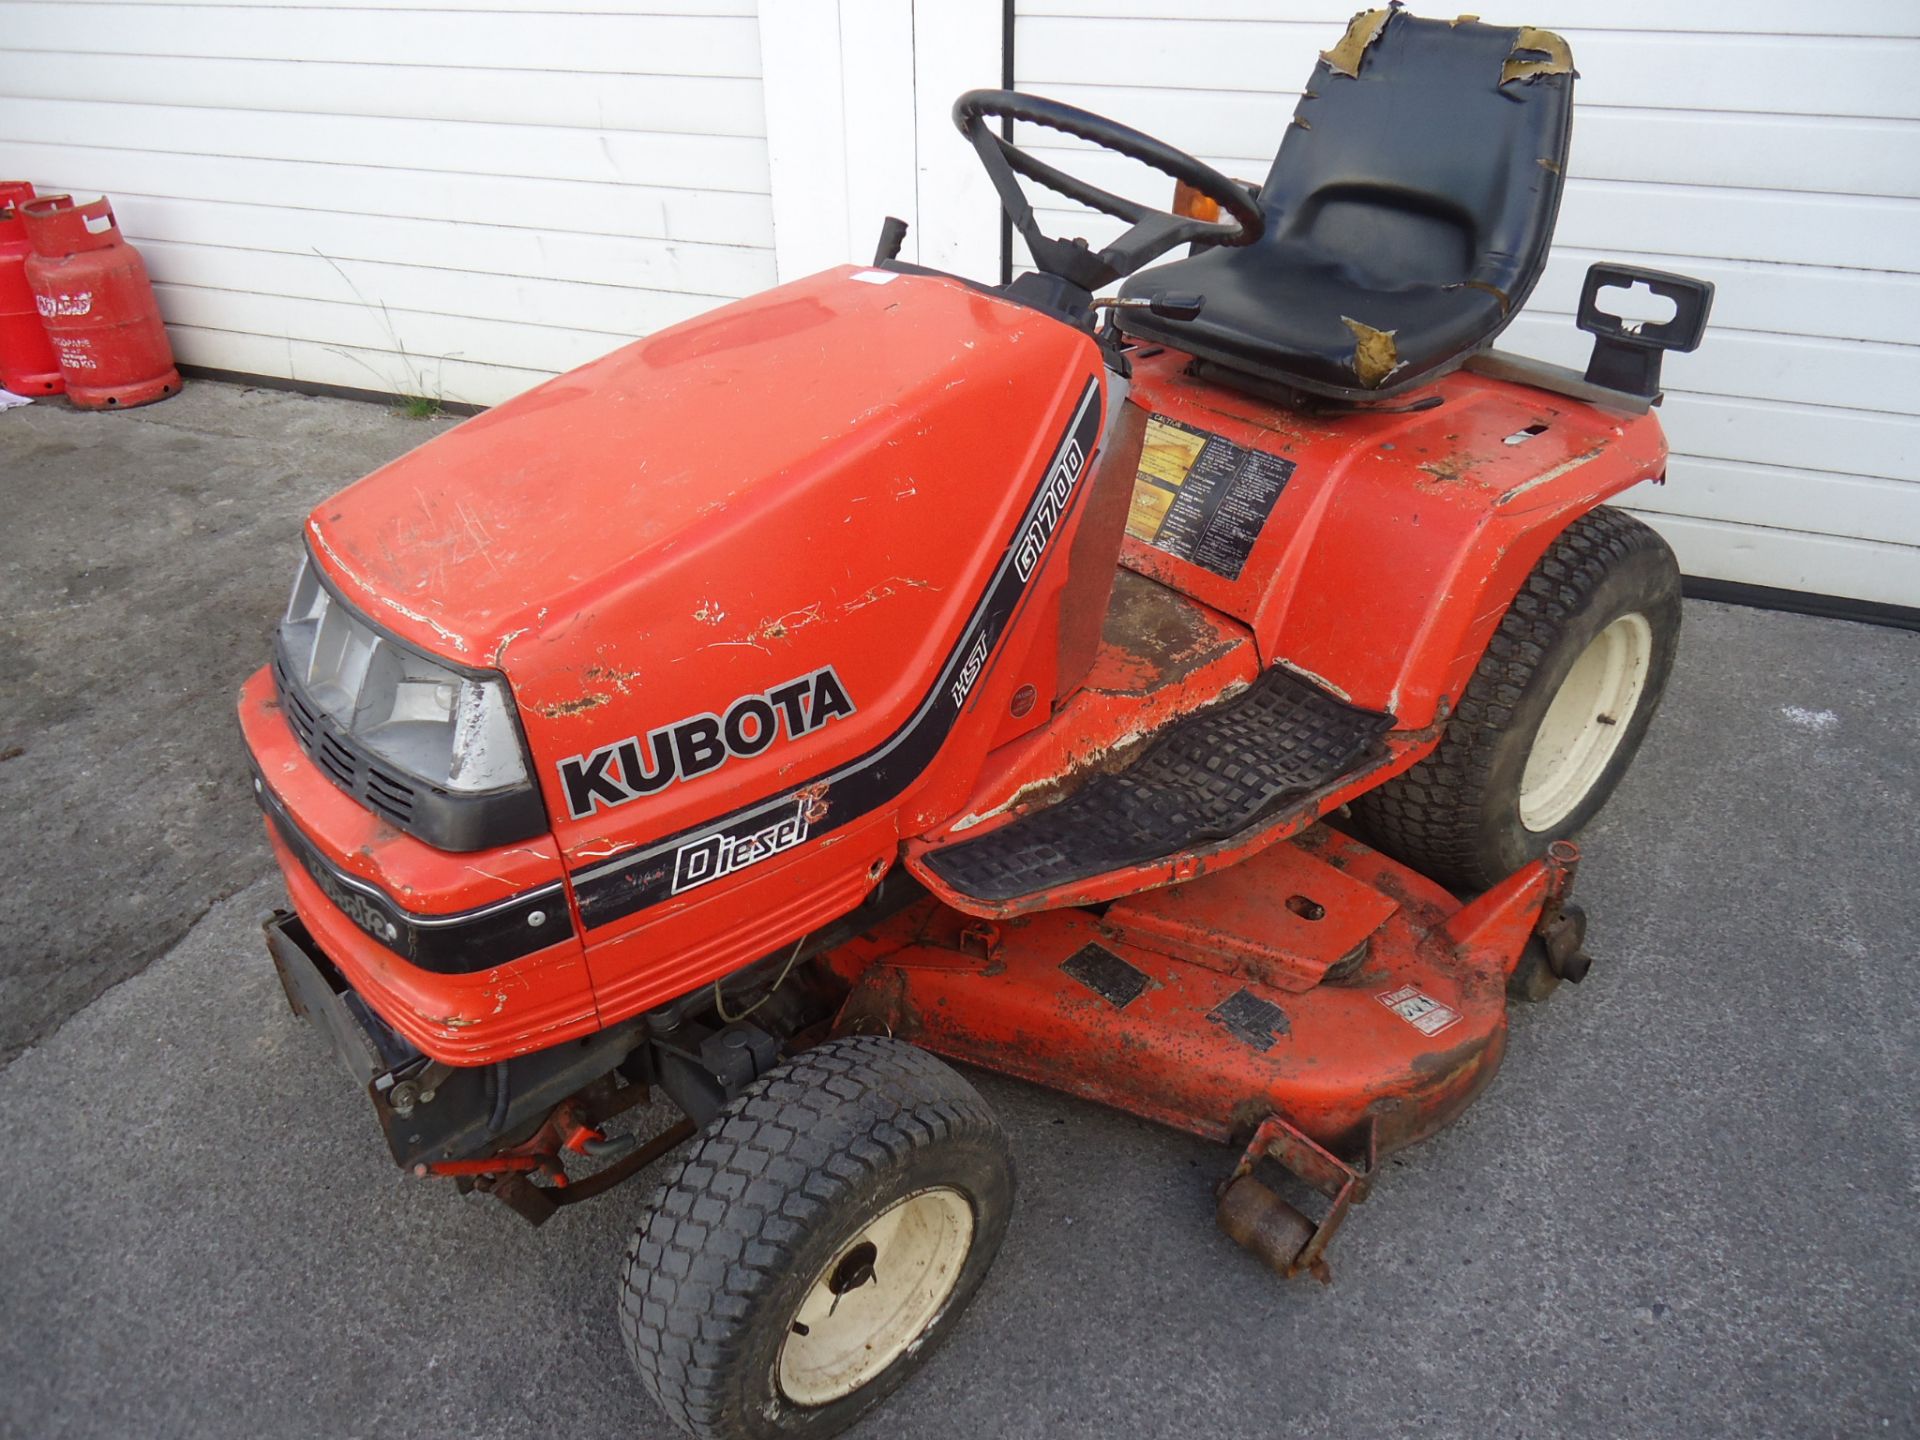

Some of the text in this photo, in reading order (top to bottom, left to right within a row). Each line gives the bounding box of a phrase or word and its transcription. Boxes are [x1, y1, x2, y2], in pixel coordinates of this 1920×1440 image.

[1014, 438, 1084, 583] G1700
[951, 629, 988, 709] HST
[556, 664, 857, 820] KUBOTA
[671, 795, 813, 895] Diesel
